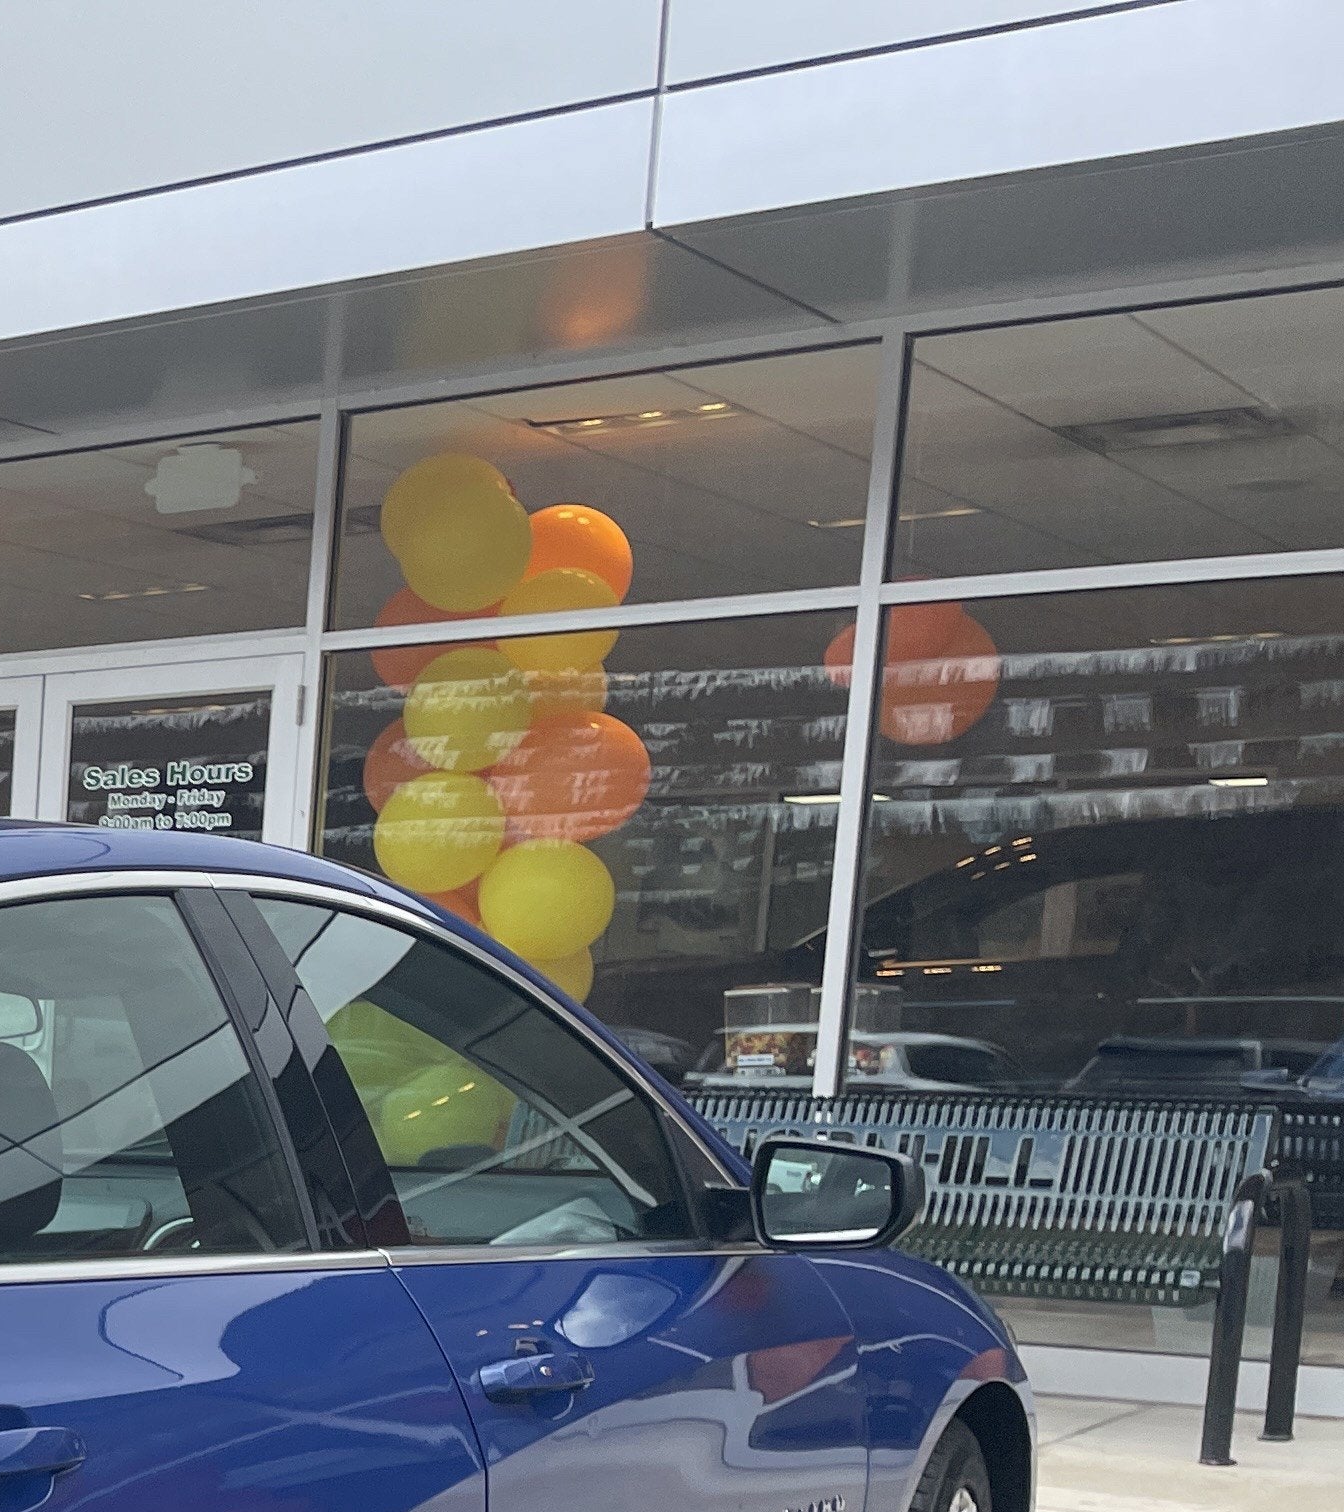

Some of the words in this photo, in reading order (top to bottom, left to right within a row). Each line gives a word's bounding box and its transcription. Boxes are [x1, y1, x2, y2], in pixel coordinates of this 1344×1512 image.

[83, 765, 160, 790] Sales
[167, 761, 253, 785] Hours
[108, 792, 167, 810] Monday
[176, 789, 226, 807] Friday
[155, 813, 173, 829] to
